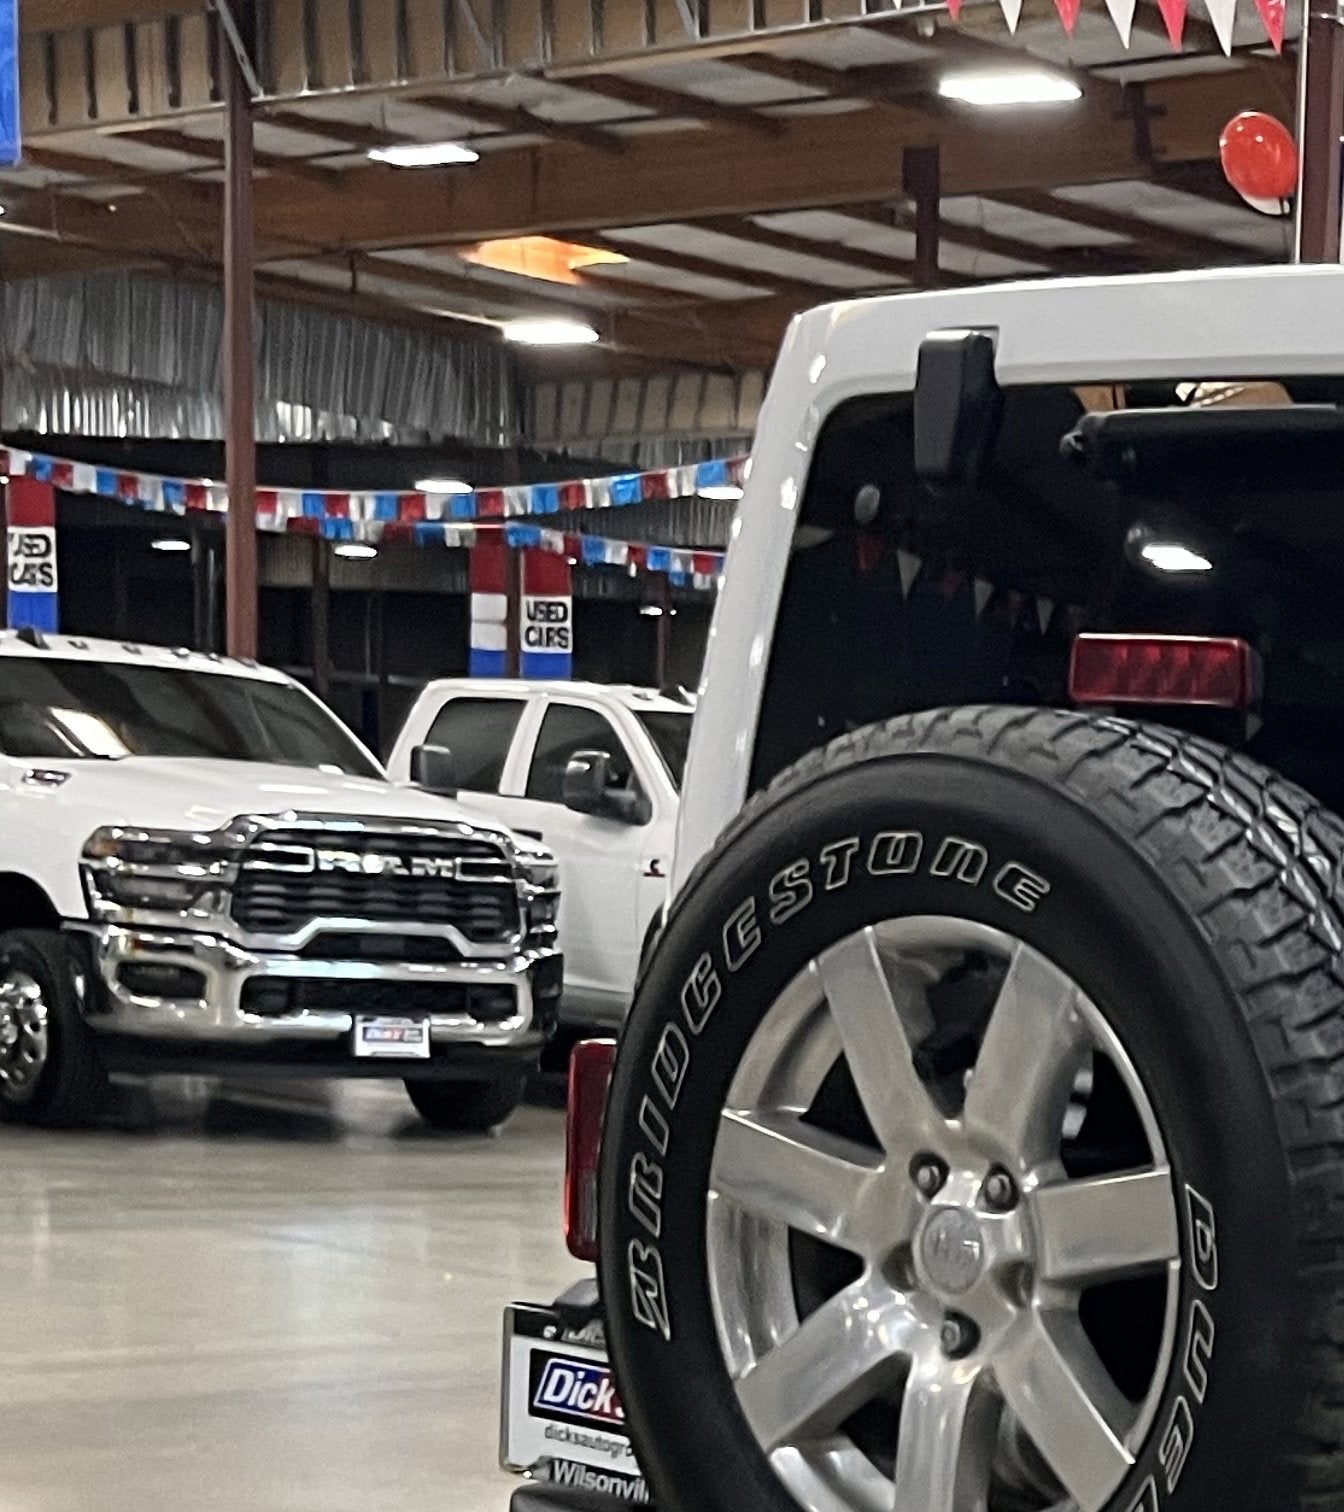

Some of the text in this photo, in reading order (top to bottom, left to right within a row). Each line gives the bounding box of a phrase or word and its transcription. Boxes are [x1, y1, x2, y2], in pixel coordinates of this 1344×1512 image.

[525, 600, 569, 623] USED
[316, 849, 455, 878] RAM
[628, 830, 1051, 1342] BRIDGESTONE
